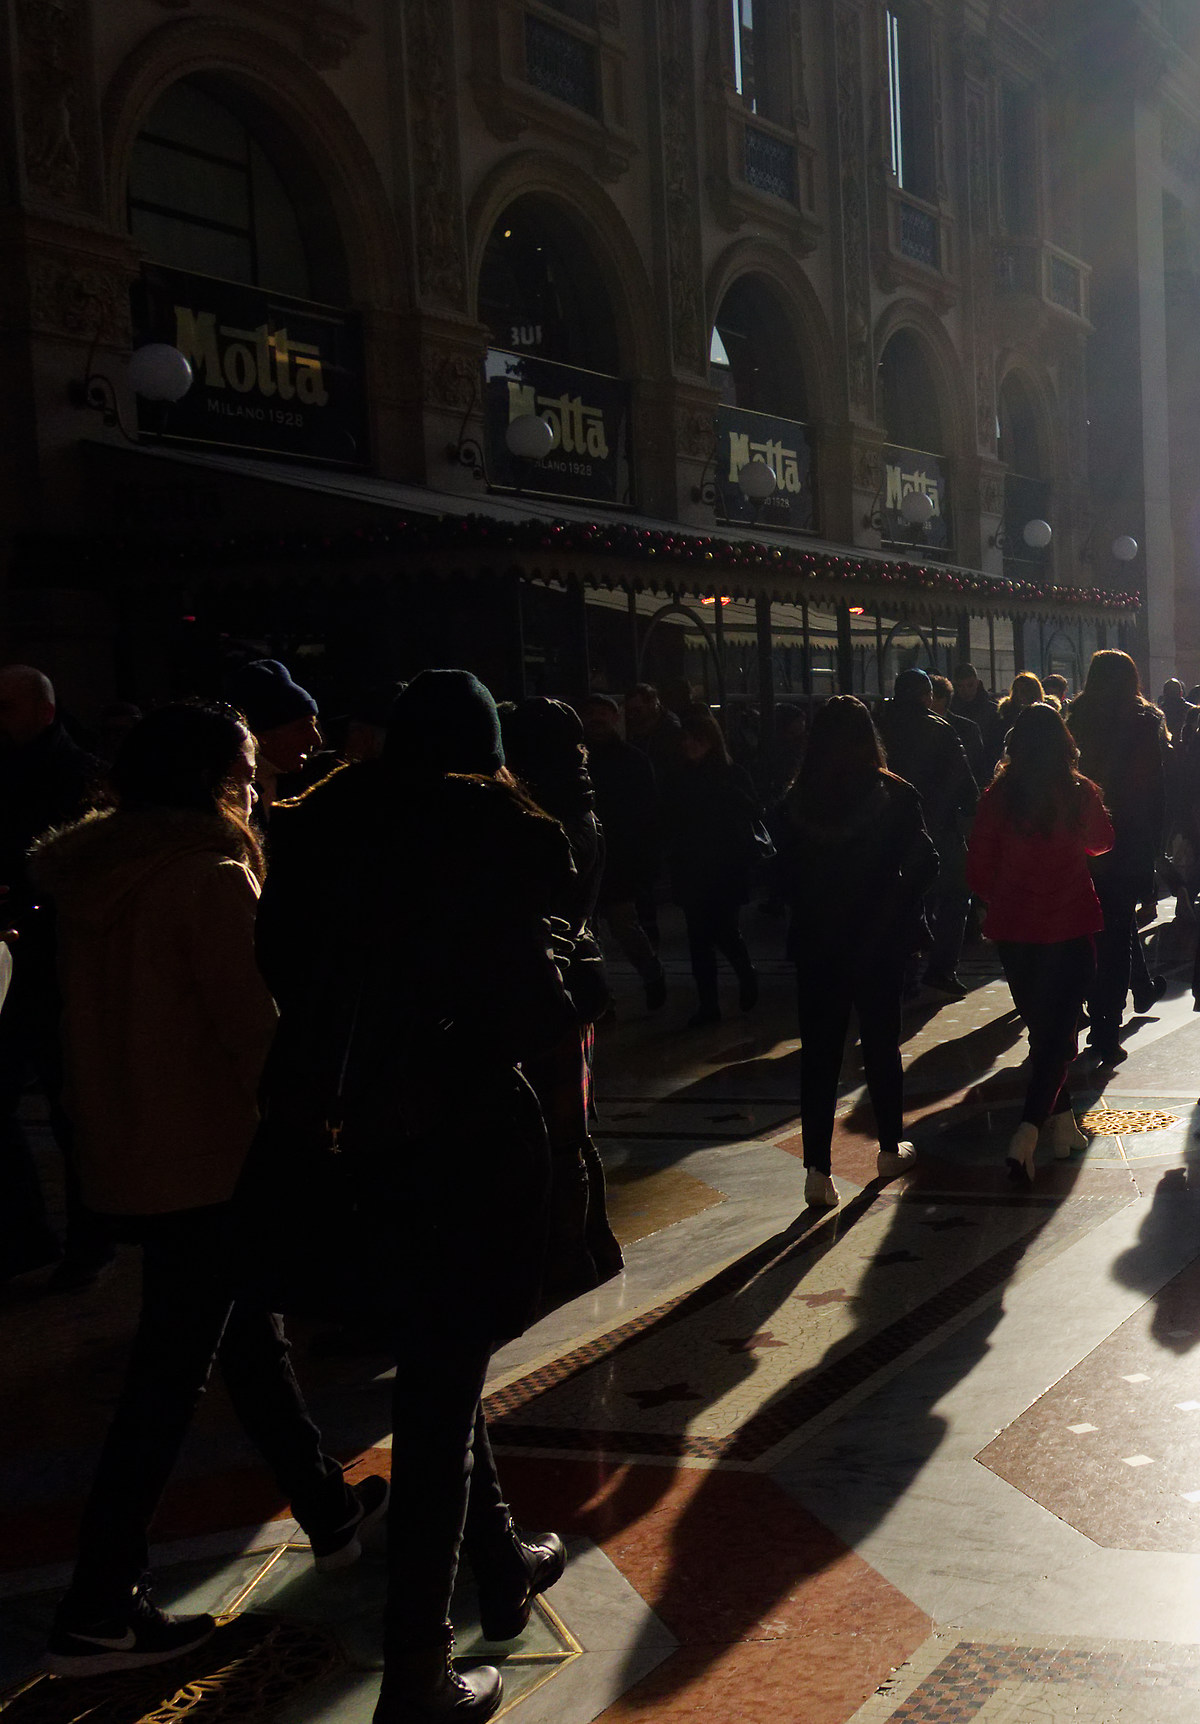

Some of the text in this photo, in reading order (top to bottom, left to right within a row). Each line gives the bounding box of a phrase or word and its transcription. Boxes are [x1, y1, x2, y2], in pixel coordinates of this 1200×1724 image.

[174, 305, 329, 407] Motta
[269, 409, 304, 428] 1928
[534, 459, 593, 477] ILANO 1928
[728, 431, 802, 494] Mtta
